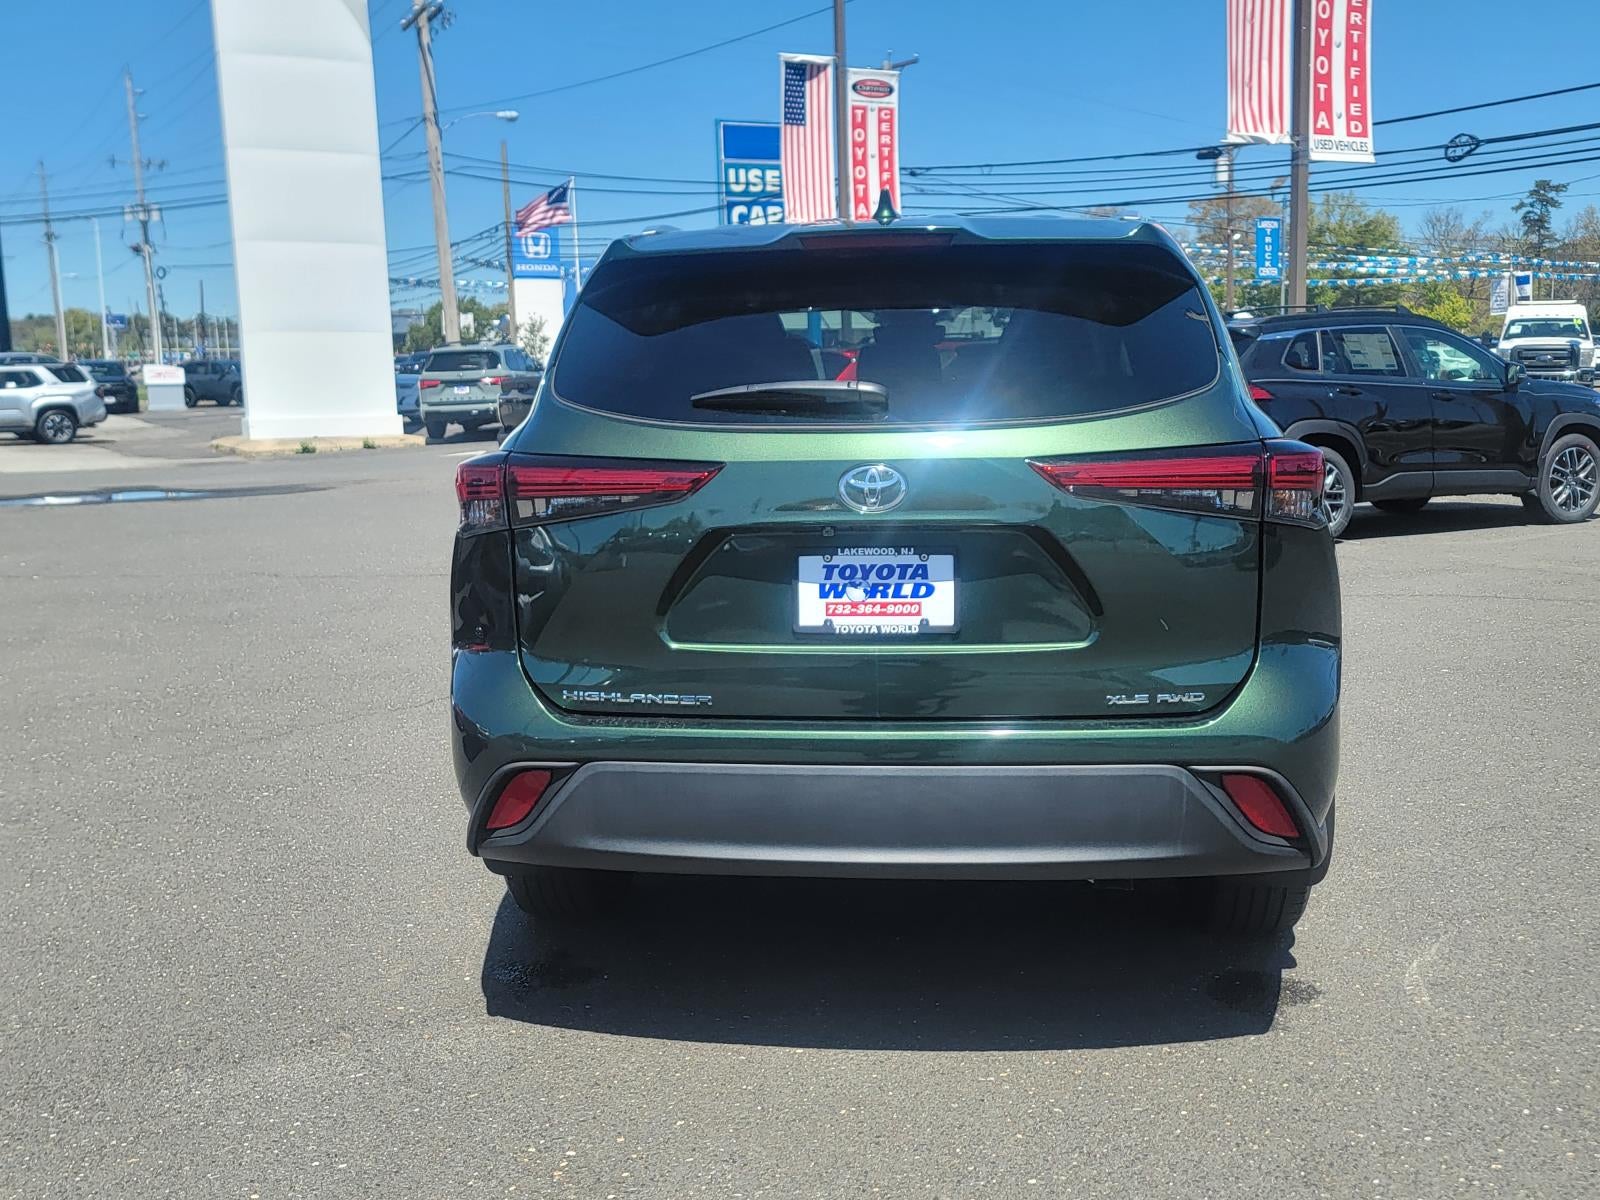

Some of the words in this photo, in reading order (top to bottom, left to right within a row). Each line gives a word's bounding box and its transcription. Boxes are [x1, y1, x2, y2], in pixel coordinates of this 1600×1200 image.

[1316, 0, 1331, 129] OYOTA
[1349, 0, 1363, 133] ERTIFIED
[880, 109, 892, 190] CERTIF
[1313, 138, 1335, 152] USED
[1335, 139, 1368, 152] VEHICLES
[853, 109, 868, 216] TOYOTA
[727, 168, 780, 193] USE
[730, 205, 784, 226] CAR
[1264, 228, 1273, 267] TRUCK
[516, 263, 558, 271] HONDA
[838, 547, 898, 557] LAKEWOOD,
[901, 547, 915, 556] NJ
[822, 563, 929, 581] TOYOTA
[818, 581, 936, 601] WORLD
[827, 604, 920, 614] 732-364-9000
[834, 624, 879, 634] TOYOTA
[880, 624, 919, 634] WORLD
[562, 689, 713, 706] HIGHLANDER
[1105, 694, 1150, 705] XLE
[1156, 692, 1206, 703] AWD
